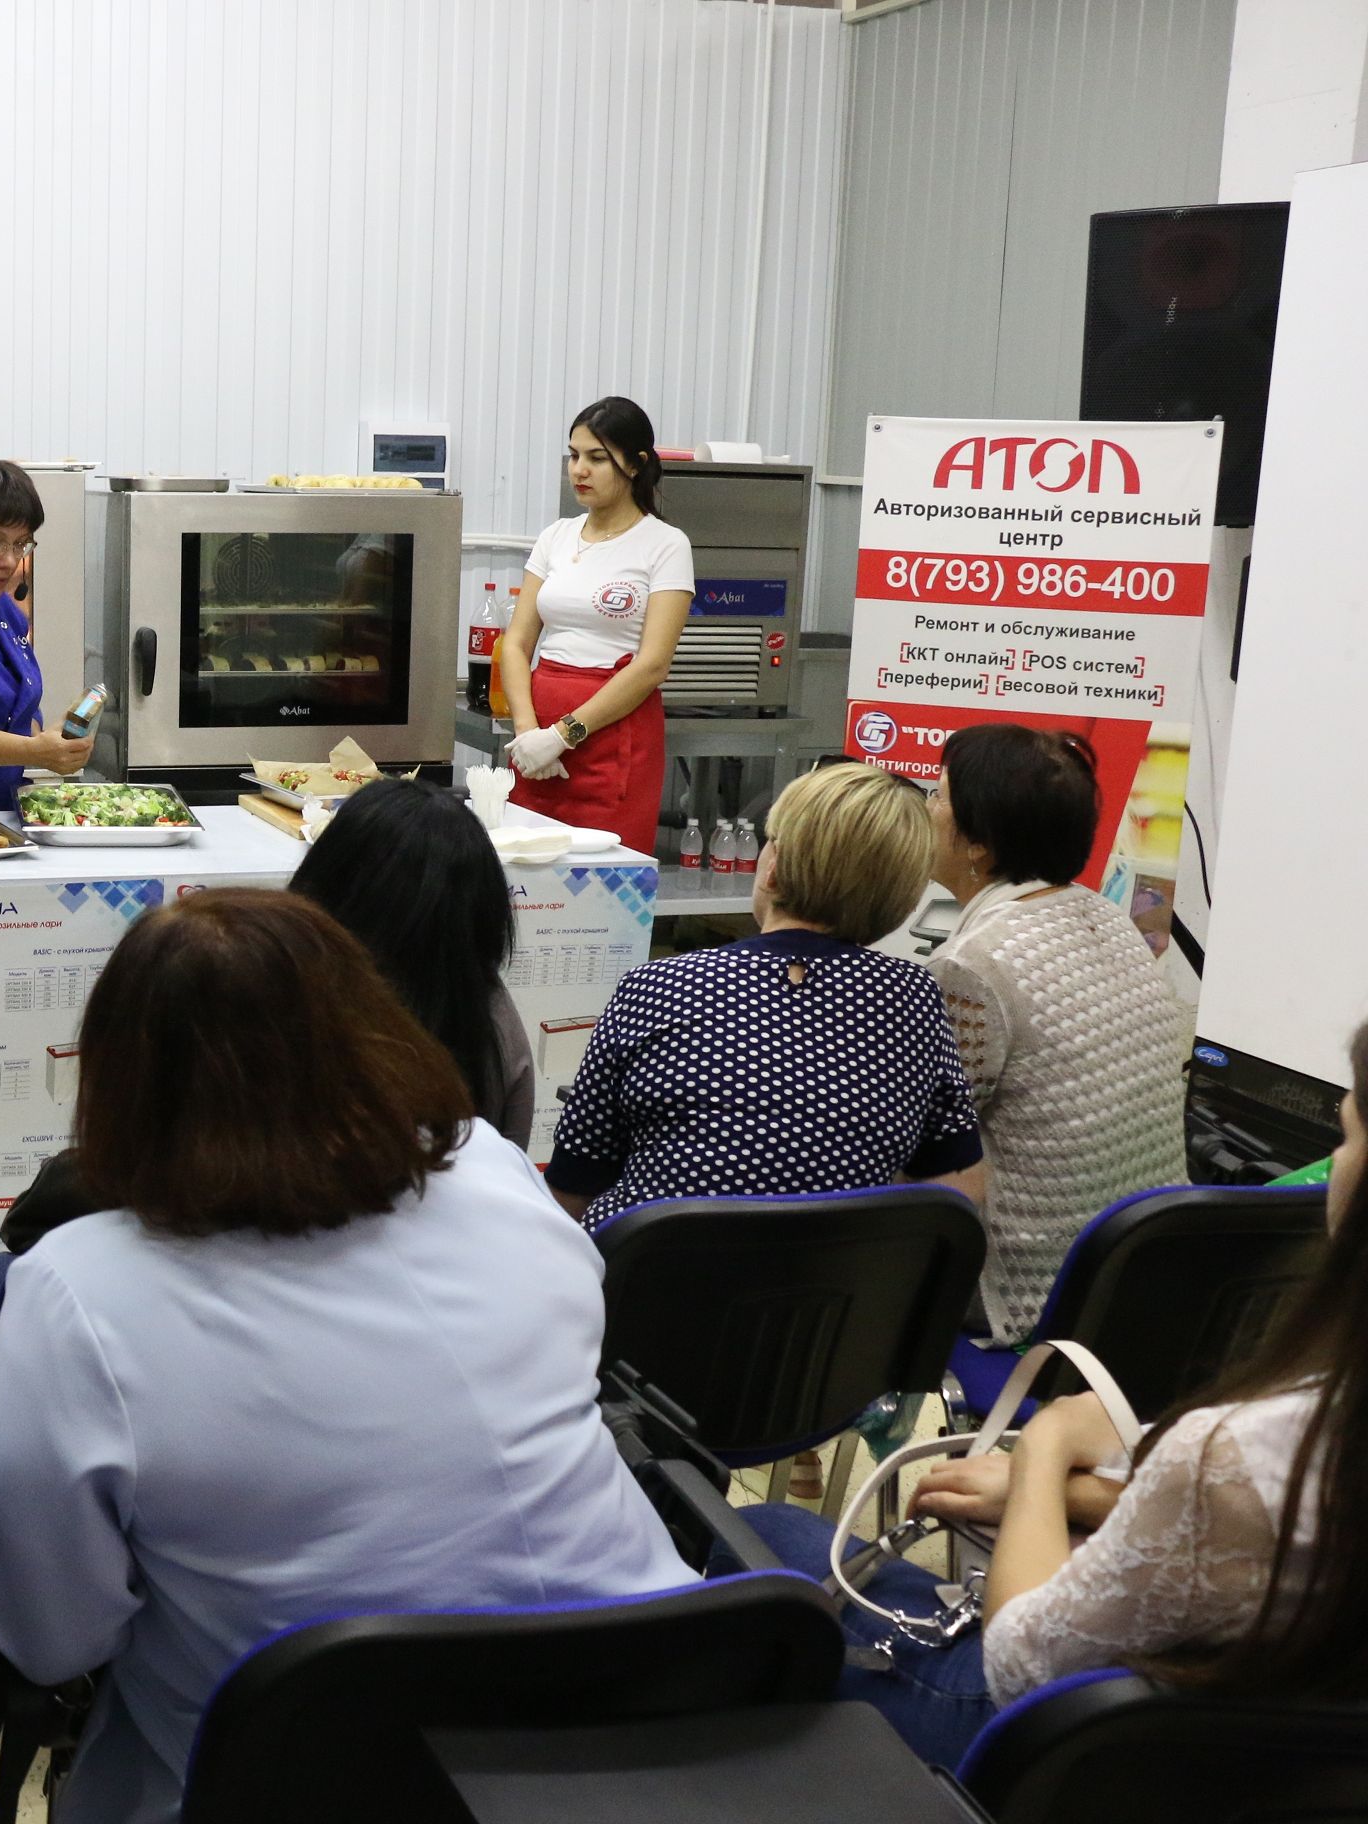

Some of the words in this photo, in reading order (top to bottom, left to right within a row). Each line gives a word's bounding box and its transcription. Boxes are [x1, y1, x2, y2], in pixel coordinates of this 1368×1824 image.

[874, 498, 1063, 522] Авторизованный
[1070, 508, 1202, 527] сервисный
[999, 530, 1063, 550] центр
[886, 556, 1005, 601] 8(793)
[1016, 562, 1175, 602] 986-400
[717, 591, 745, 604] Abat
[915, 615, 979, 632] Ремонт
[985, 623, 995, 633] и
[1001, 621, 1136, 641] обслуживание
[905, 646, 940, 661] ККТ
[944, 651, 1010, 666] онлайн
[1028, 654, 1067, 670] POS
[1073, 661, 1139, 675] систем
[883, 671, 984, 689] переферии
[1002, 679, 1078, 696] весовой
[1084, 685, 1159, 702] техники
[289, 705, 311, 716] Abat
[865, 755, 941, 776] Пятигорс
[545, 902, 564, 911] лари
[40, 919, 63, 928] лари
